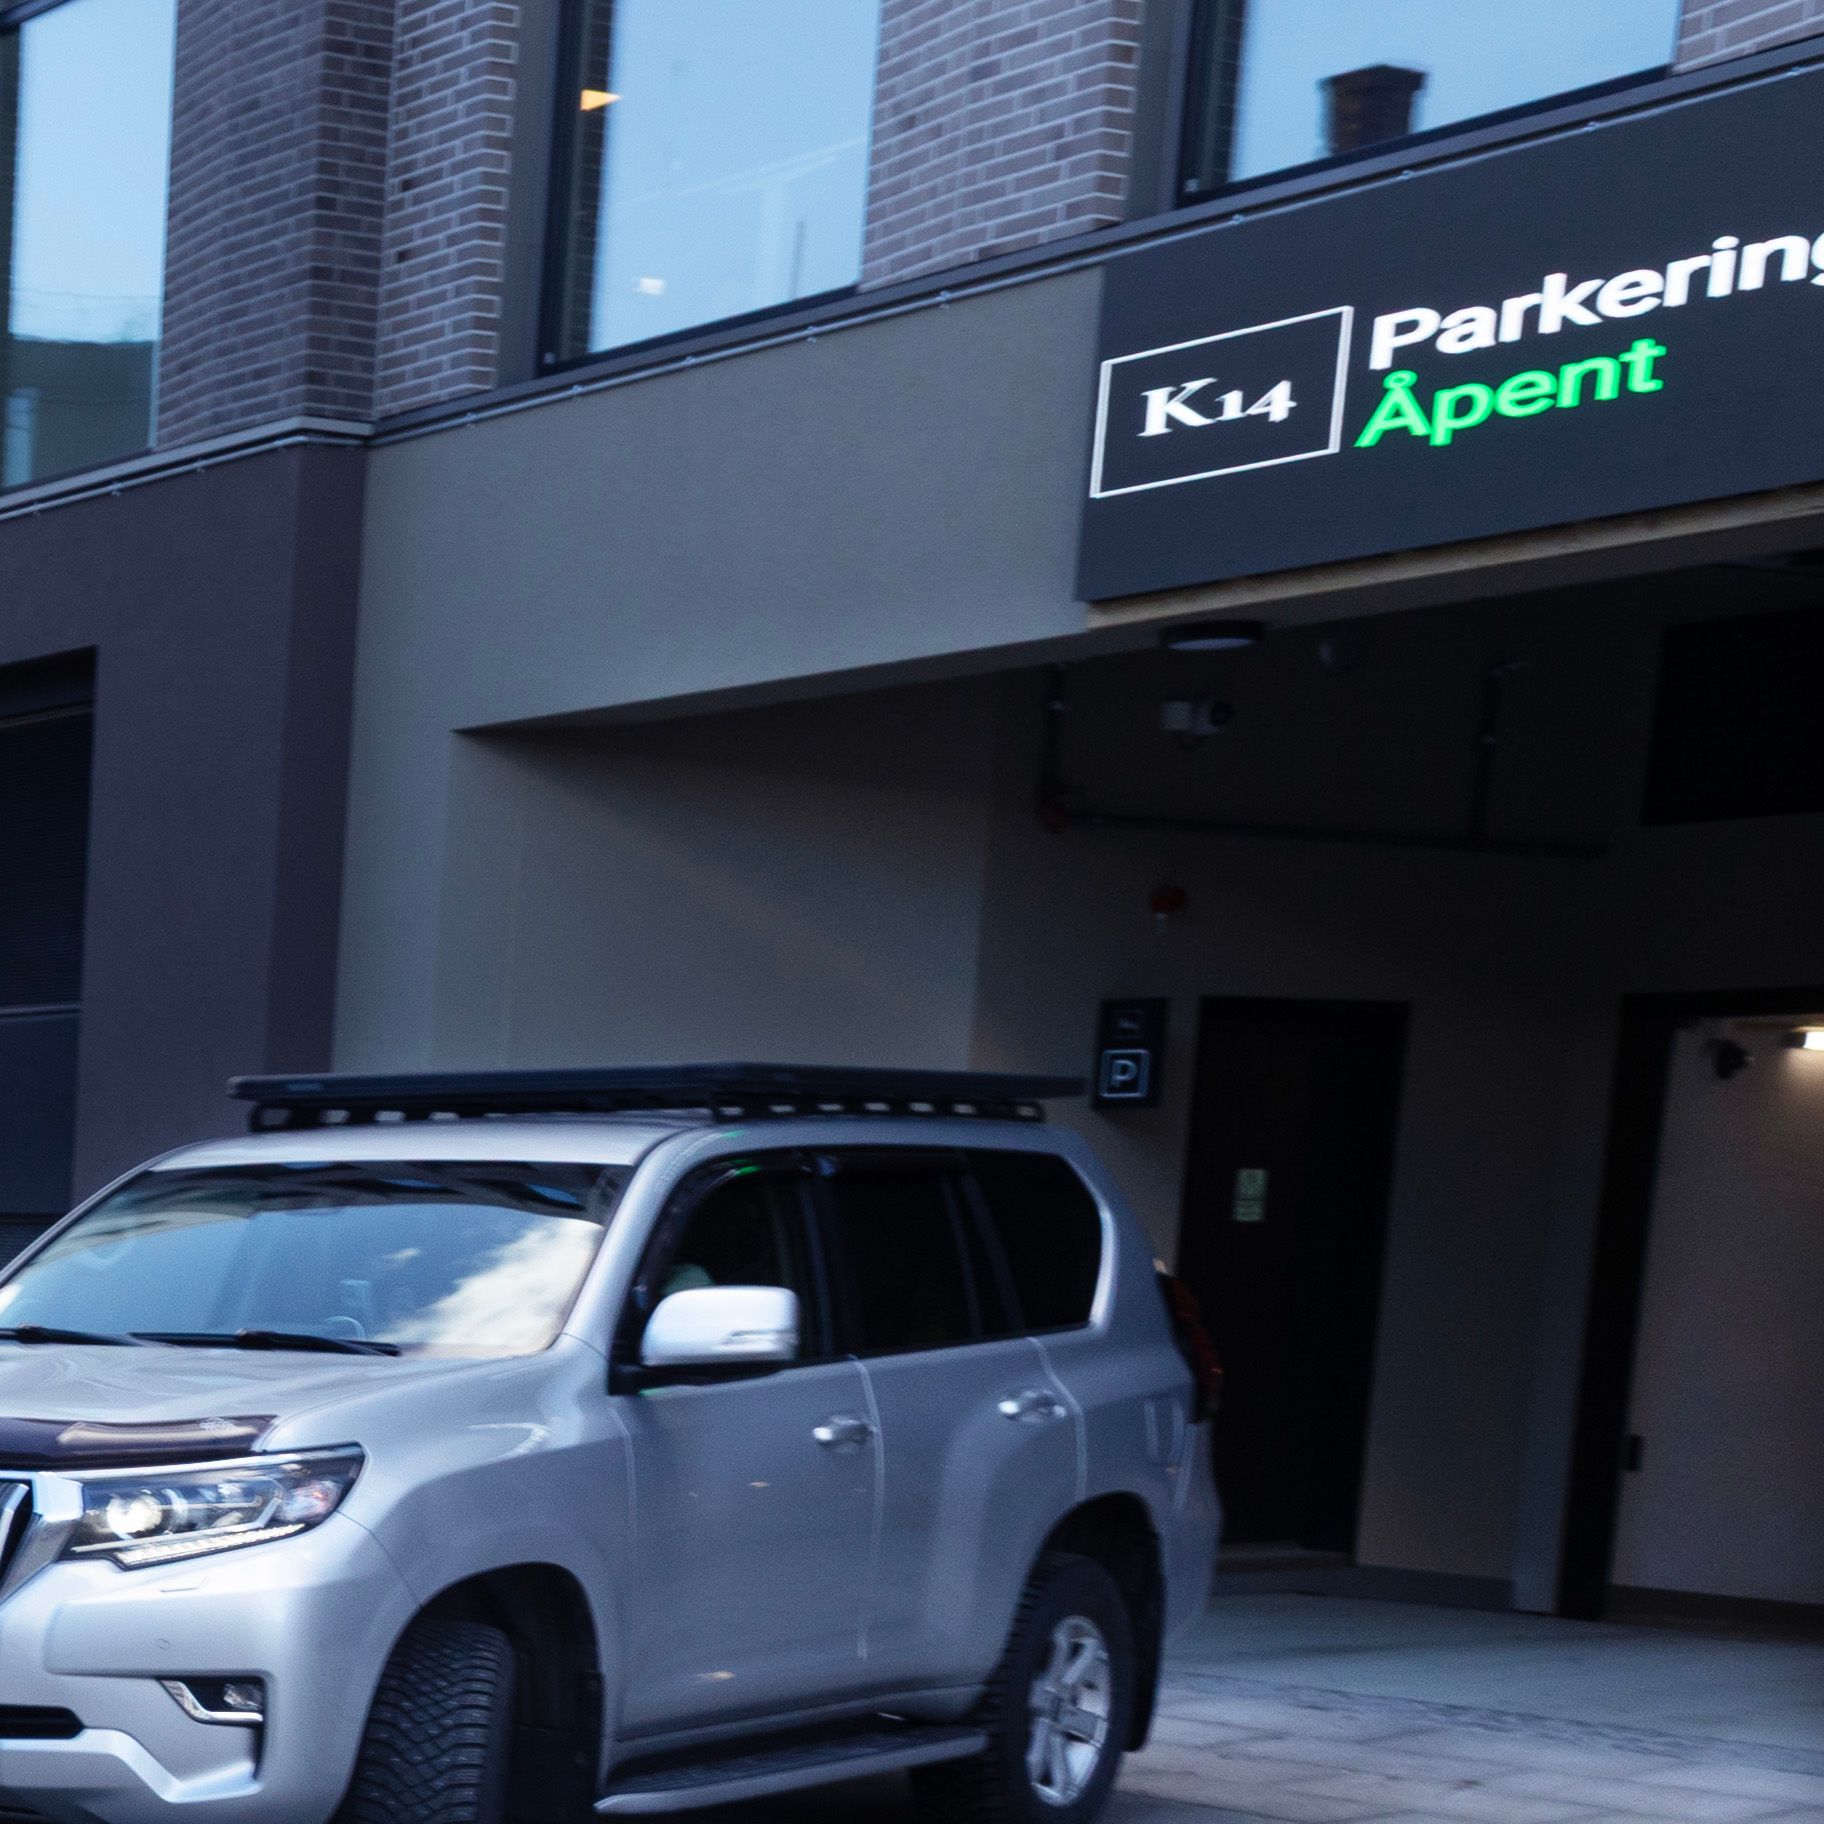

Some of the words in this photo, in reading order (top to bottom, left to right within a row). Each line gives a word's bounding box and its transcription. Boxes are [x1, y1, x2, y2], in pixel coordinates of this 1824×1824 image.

[1369, 232, 1824, 370] Parkerin
[1138, 377, 1297, 437] K14
[1354, 337, 1667, 447] Åpent
[1109, 1058, 1139, 1088] P
